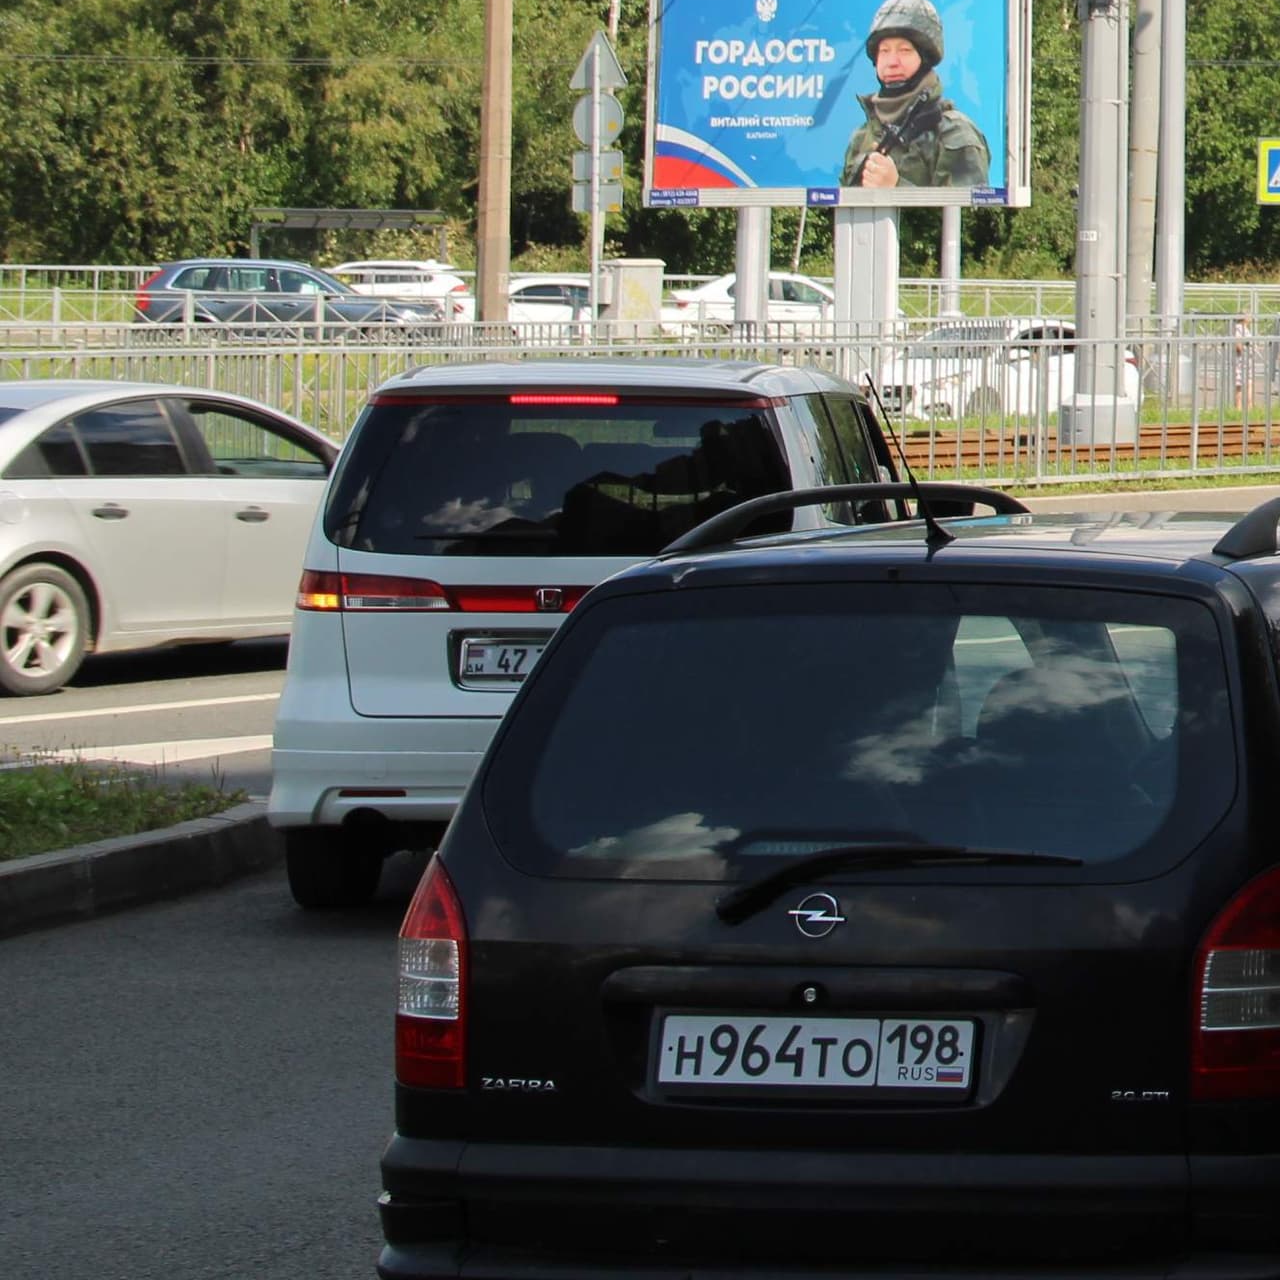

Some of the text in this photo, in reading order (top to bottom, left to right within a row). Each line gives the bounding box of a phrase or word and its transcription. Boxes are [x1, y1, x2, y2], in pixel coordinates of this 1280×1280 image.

[695, 38, 835, 67] ГОРДОСТЬ
[702, 74, 823, 100] РОССИИ!
[710, 114, 760, 128] ВИТАЛИЙ
[674, 1023, 961, 1078] Н964ТО 198
[481, 1077, 557, 1091] ZAFIRA
[897, 1066, 935, 1082] RUS
